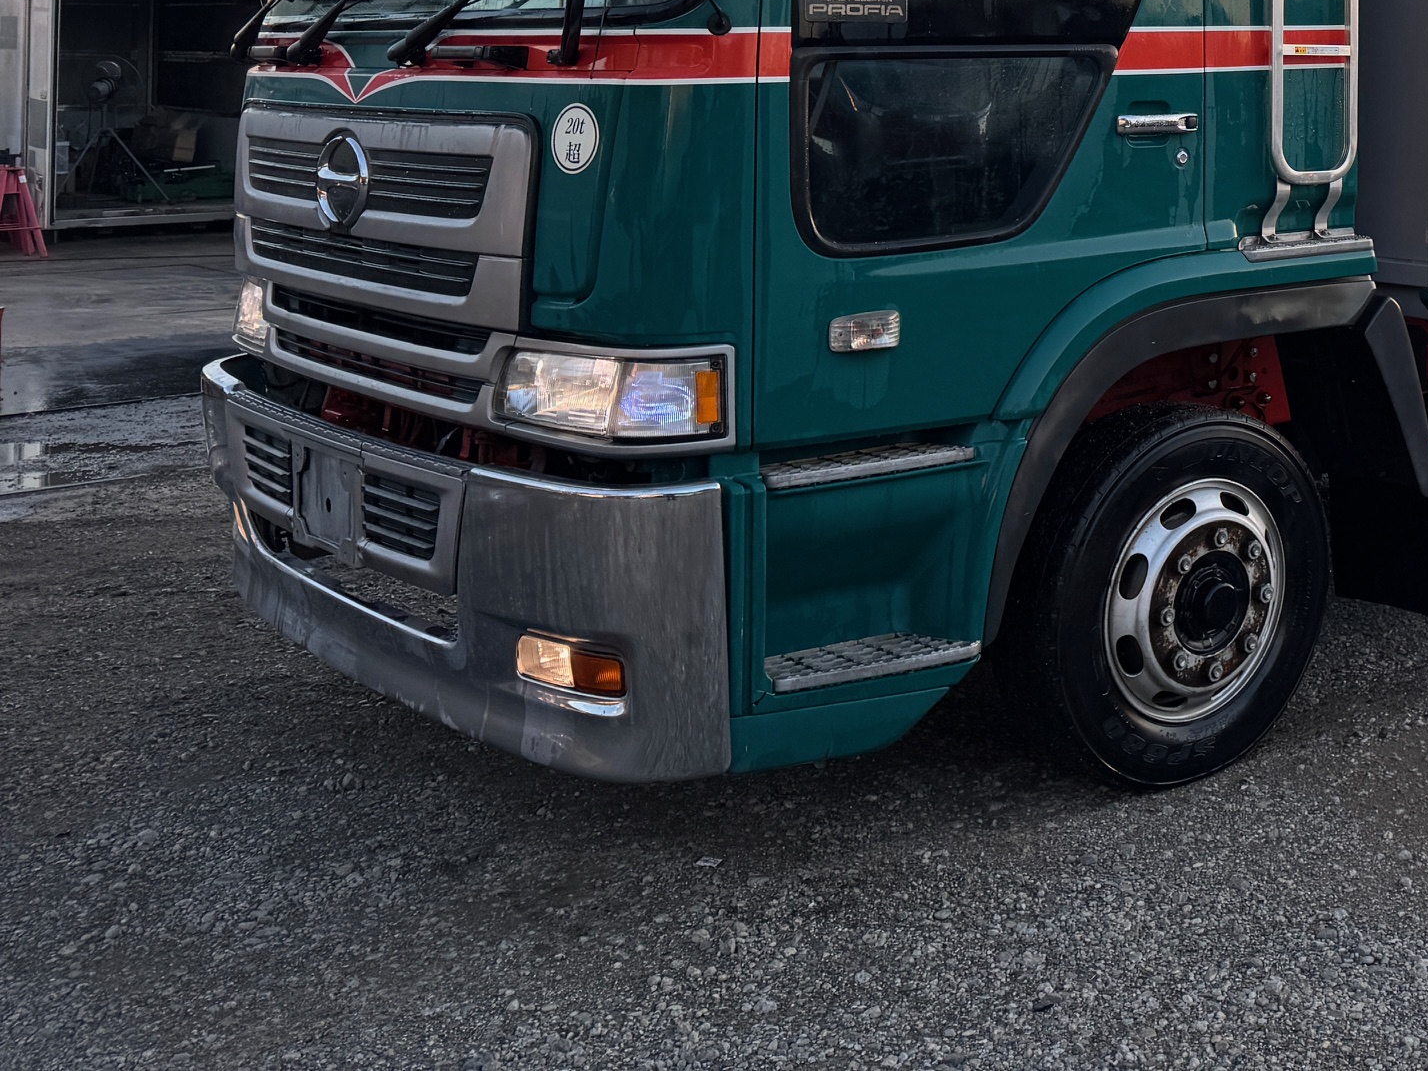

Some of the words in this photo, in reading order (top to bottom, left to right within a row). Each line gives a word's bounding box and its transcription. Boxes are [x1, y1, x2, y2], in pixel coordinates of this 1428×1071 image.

[808, 3, 904, 17] PROFIA
[565, 117, 586, 135] 20t
[565, 141, 582, 164] 超
